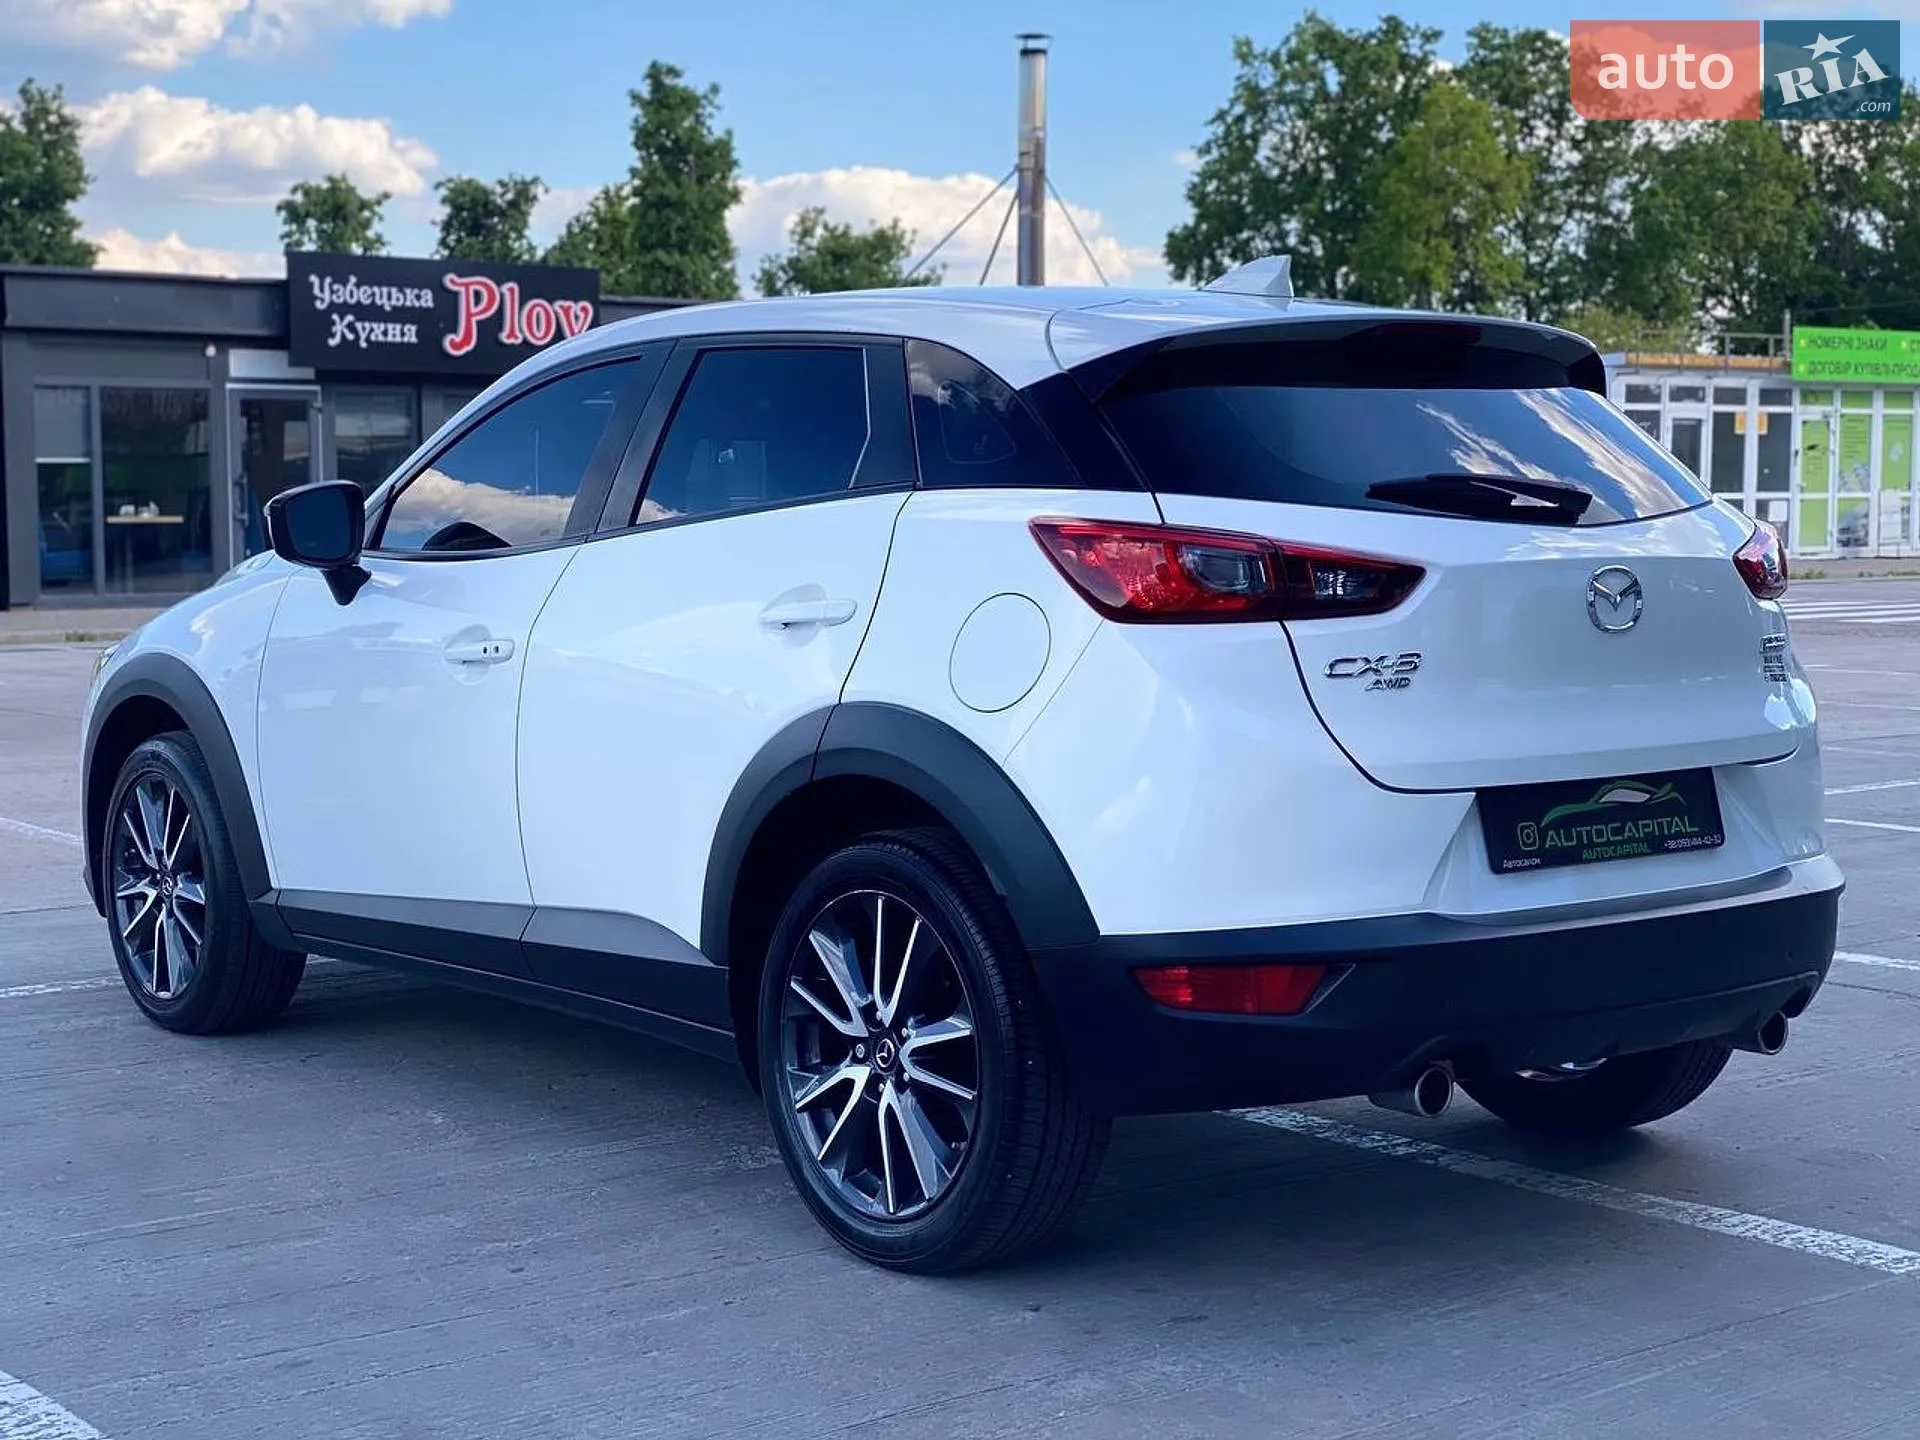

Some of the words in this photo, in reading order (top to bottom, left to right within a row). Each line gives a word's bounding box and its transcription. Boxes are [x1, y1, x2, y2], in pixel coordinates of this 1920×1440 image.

[308, 273, 435, 311] Узбецька
[327, 313, 419, 348] Кухня
[442, 273, 594, 356] Plov
[1324, 651, 1422, 679] CX-3
[1364, 676, 1412, 692] AWD
[1544, 815, 1699, 848] AUTOCAPITAL
[1581, 842, 1652, 860] AUTOCAPITAL
